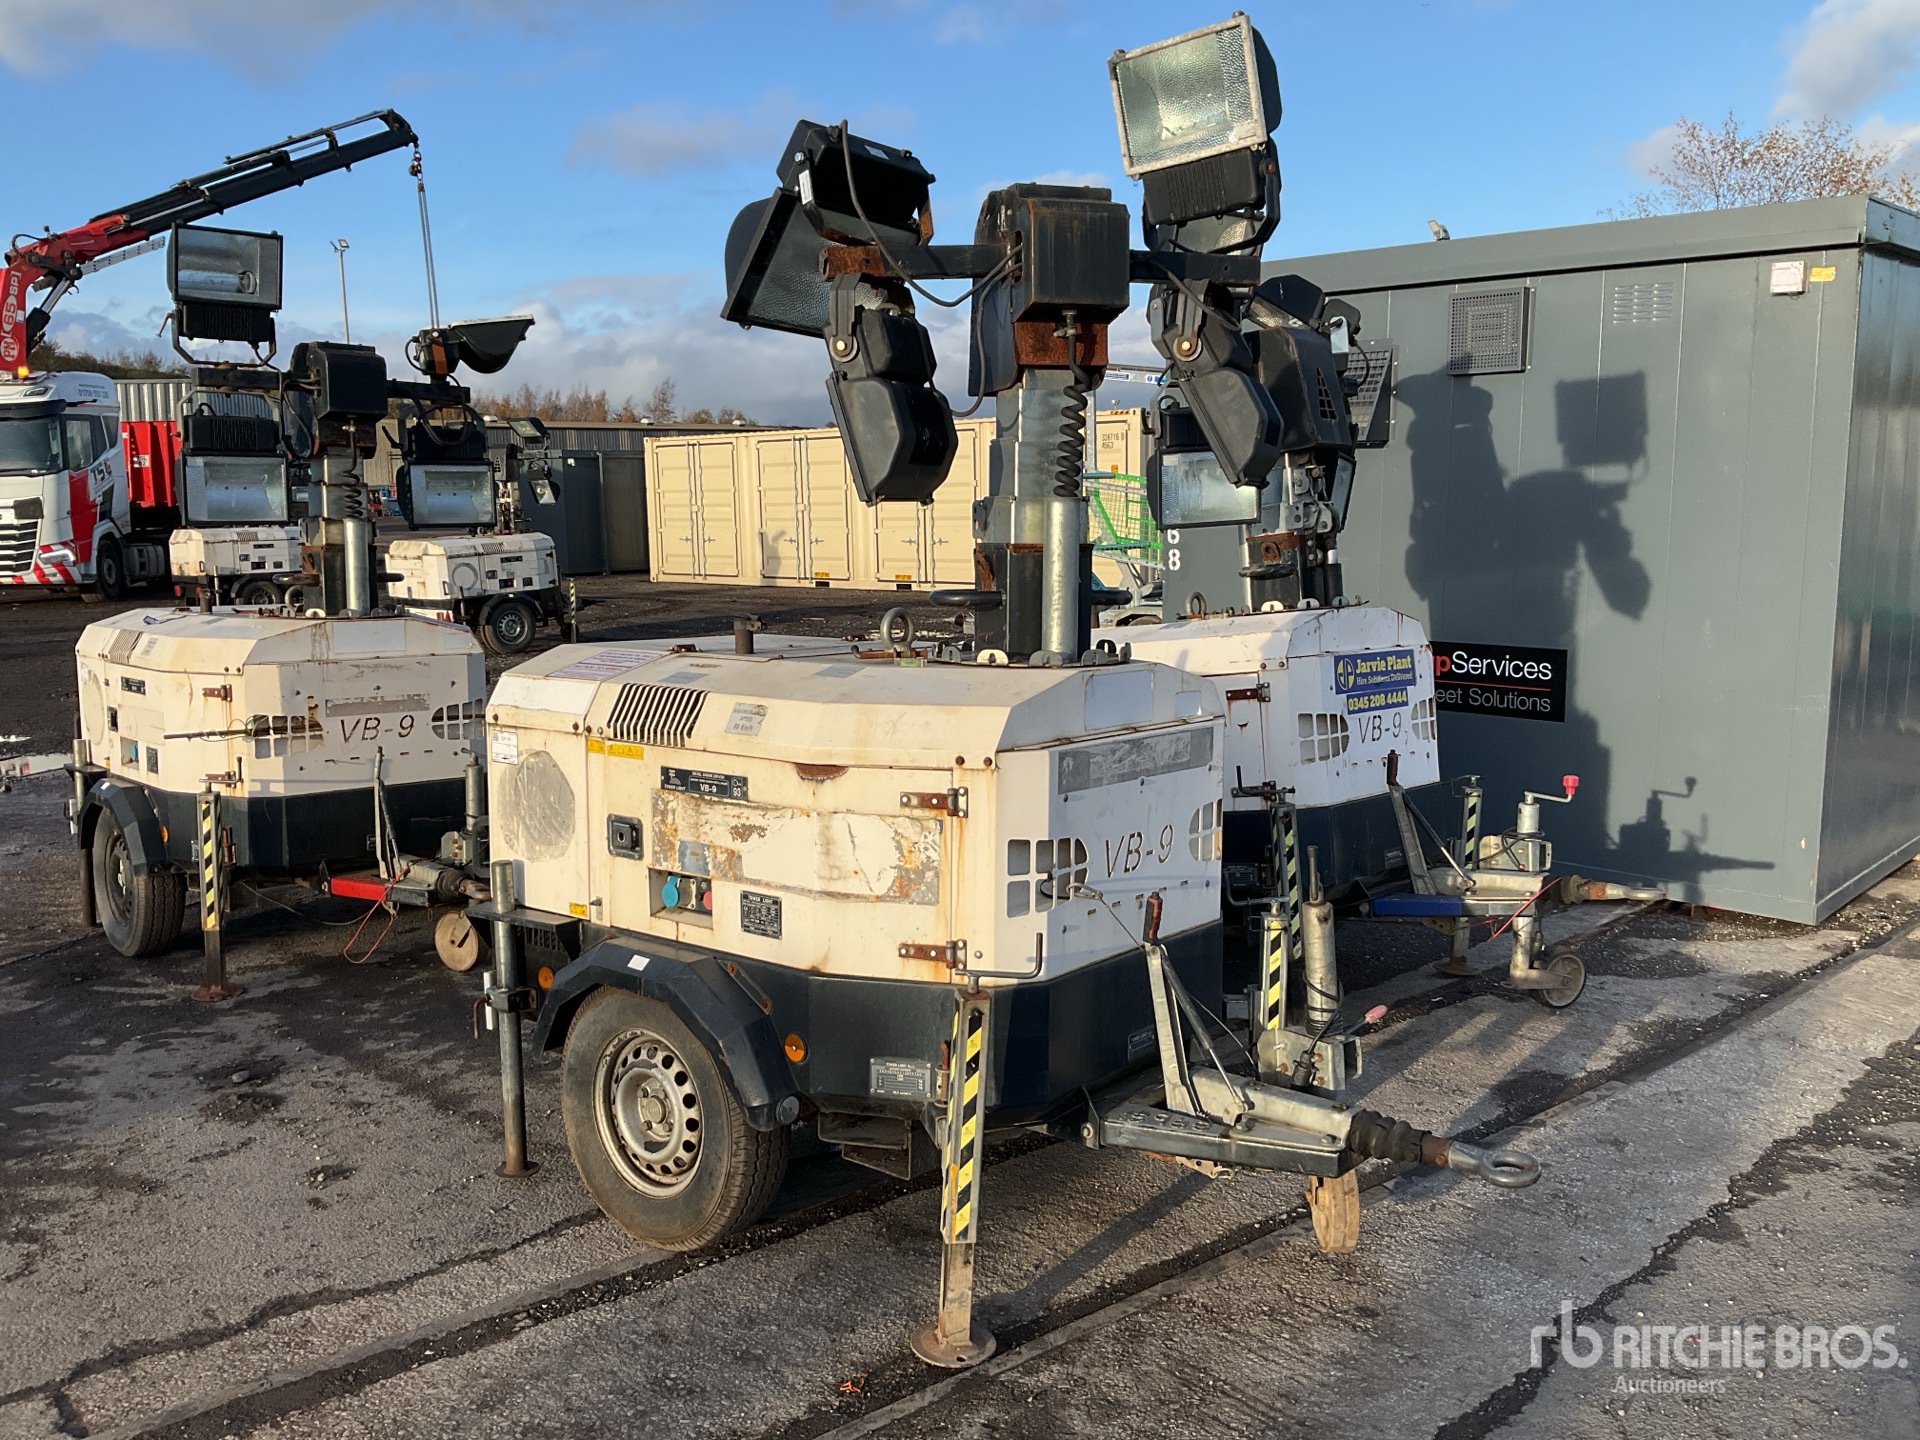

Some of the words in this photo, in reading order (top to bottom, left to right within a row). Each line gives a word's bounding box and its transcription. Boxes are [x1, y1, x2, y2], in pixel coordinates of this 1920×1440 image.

[1356, 656, 1386, 674] Jarvie
[1386, 655, 1412, 671] Plant
[1433, 650, 1552, 680] pServices
[1356, 676, 1367, 686] Hire
[1348, 696, 1369, 711] 0345
[1369, 693, 1386, 707] 208
[1386, 689, 1407, 705] 4444
[1434, 687, 1463, 704] eet
[1469, 687, 1551, 712] Solutions
[341, 714, 415, 743] VB-9
[1358, 711, 1402, 743] VB-9
[700, 783, 717, 793] VB-9
[1105, 823, 1174, 878] VB-9
